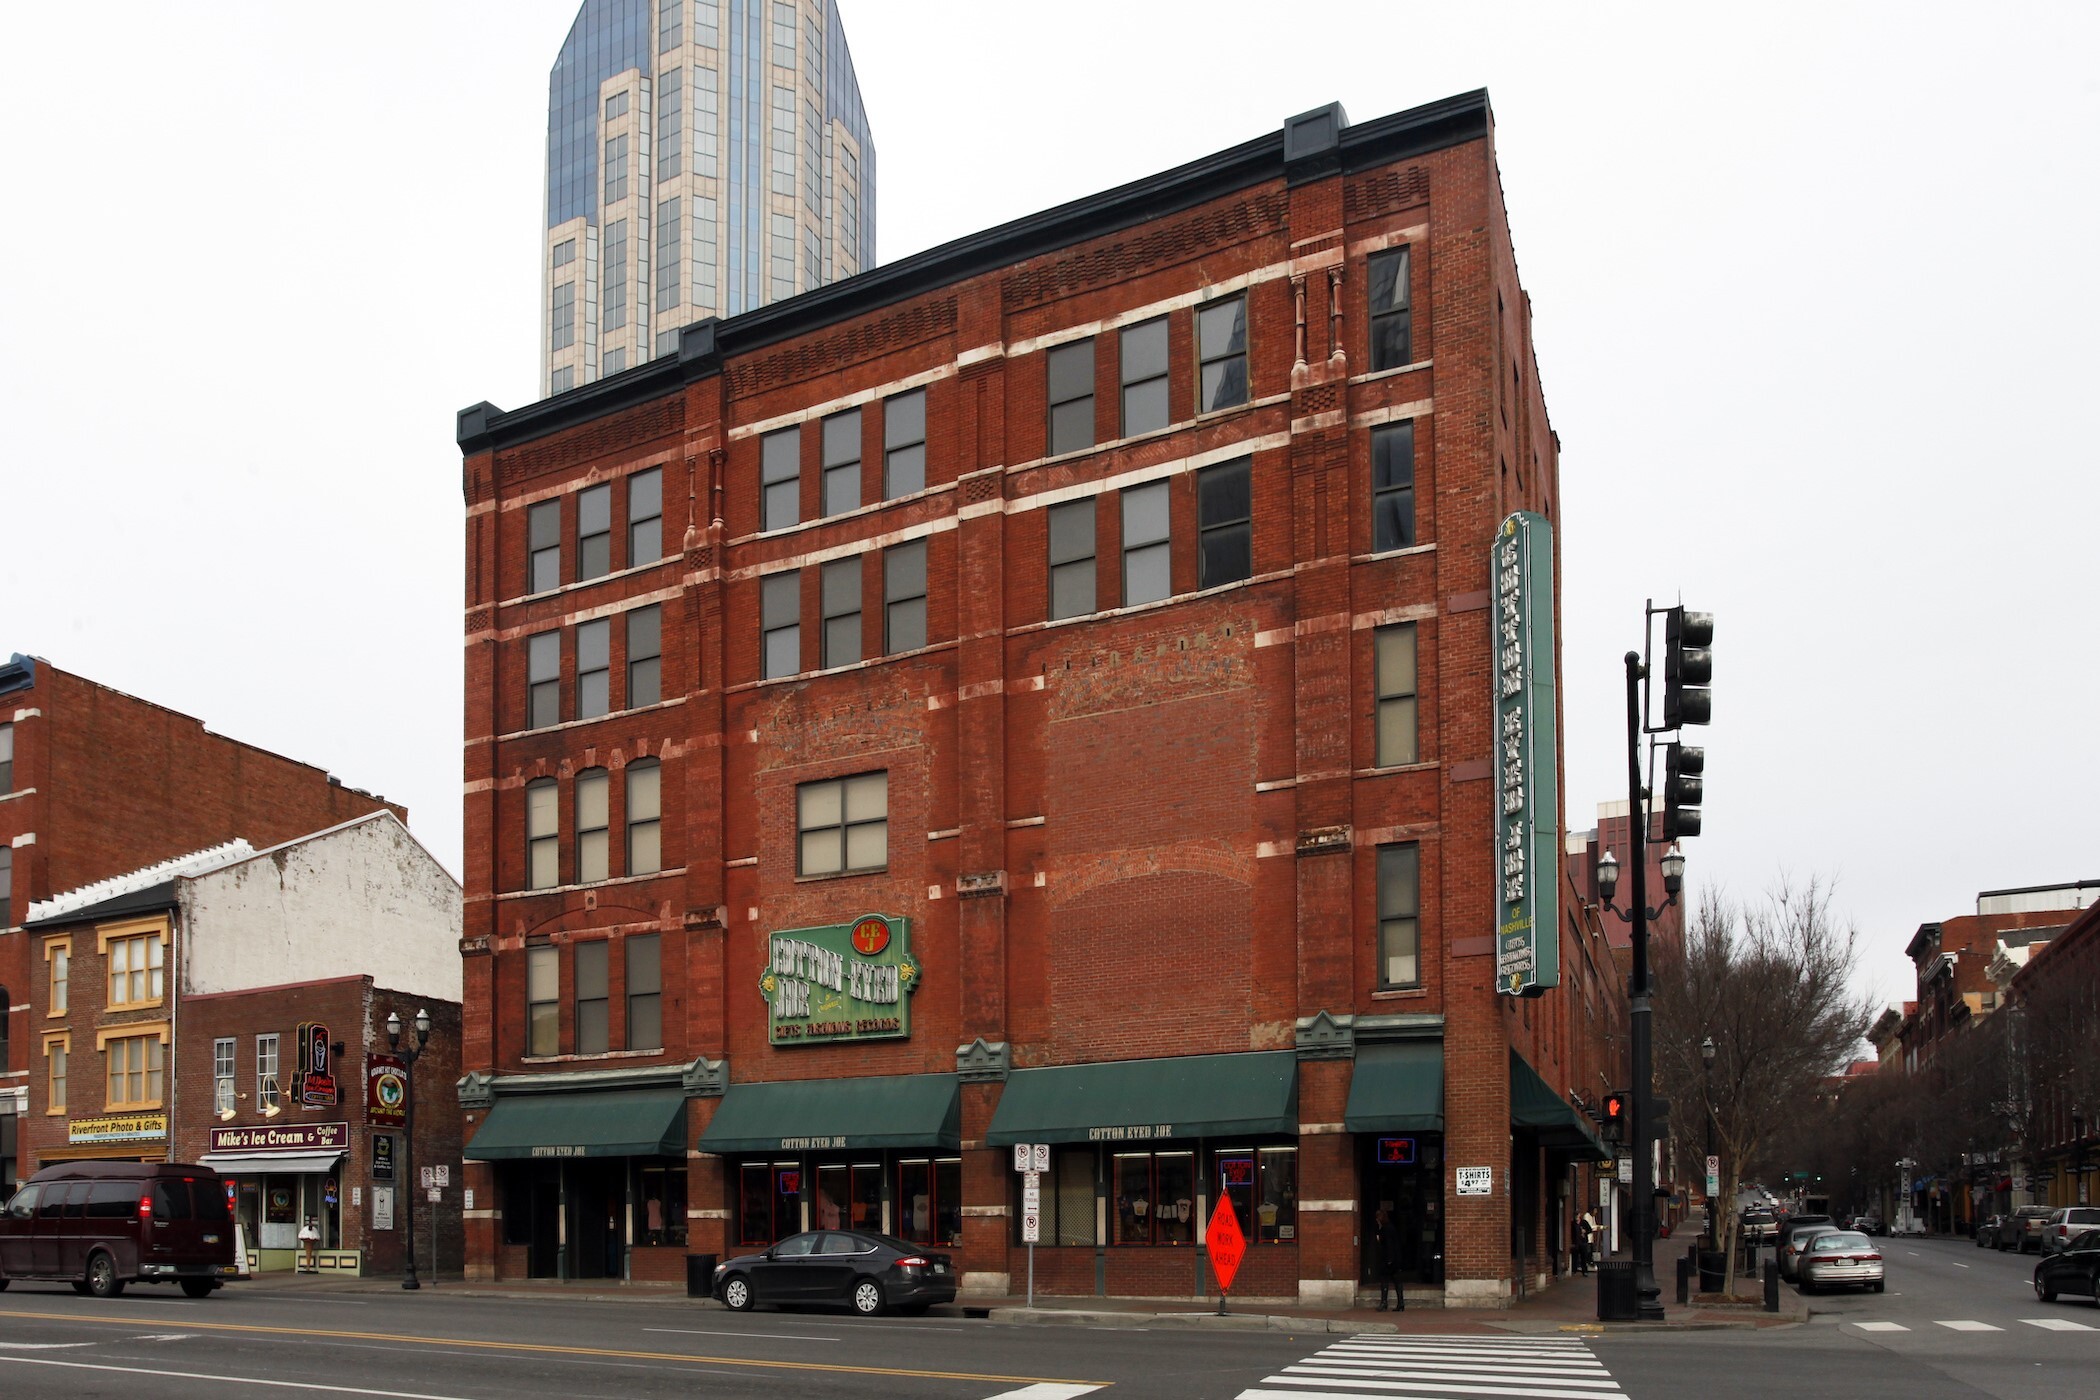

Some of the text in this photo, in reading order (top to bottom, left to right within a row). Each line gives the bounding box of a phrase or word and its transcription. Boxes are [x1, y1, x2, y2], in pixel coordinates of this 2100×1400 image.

[1500, 536, 1525, 903] COTTON EYED JOE
[1511, 906, 1521, 919] OF
[1500, 915, 1533, 936] NASHVILLE
[1505, 936, 1525, 951] GIFTS
[1499, 946, 1532, 965] FASHIONS
[1500, 958, 1531, 976] RECORDS
[775, 978, 809, 1018] JOE
[775, 1018, 900, 1038] GIFTS FASHIONS RECORDS
[71, 1120, 162, 1135] Riverfront Photo & Gifts
[316, 1126, 338, 1137] Coffee
[1089, 1125, 1172, 1140] COTTON EYED JOE
[218, 1130, 315, 1147] Mike's Ice Cream &
[321, 1137, 333, 1145] Bar
[781, 1136, 846, 1149] COTTON EYED JOE
[532, 1146, 586, 1157] COTTON EYED JOE
[1459, 1171, 1490, 1179] T-SHIRTS
[1217, 1211, 1233, 1227] ROAD
[1217, 1232, 1233, 1247] WORK
[1215, 1252, 1236, 1266] AHEAD
